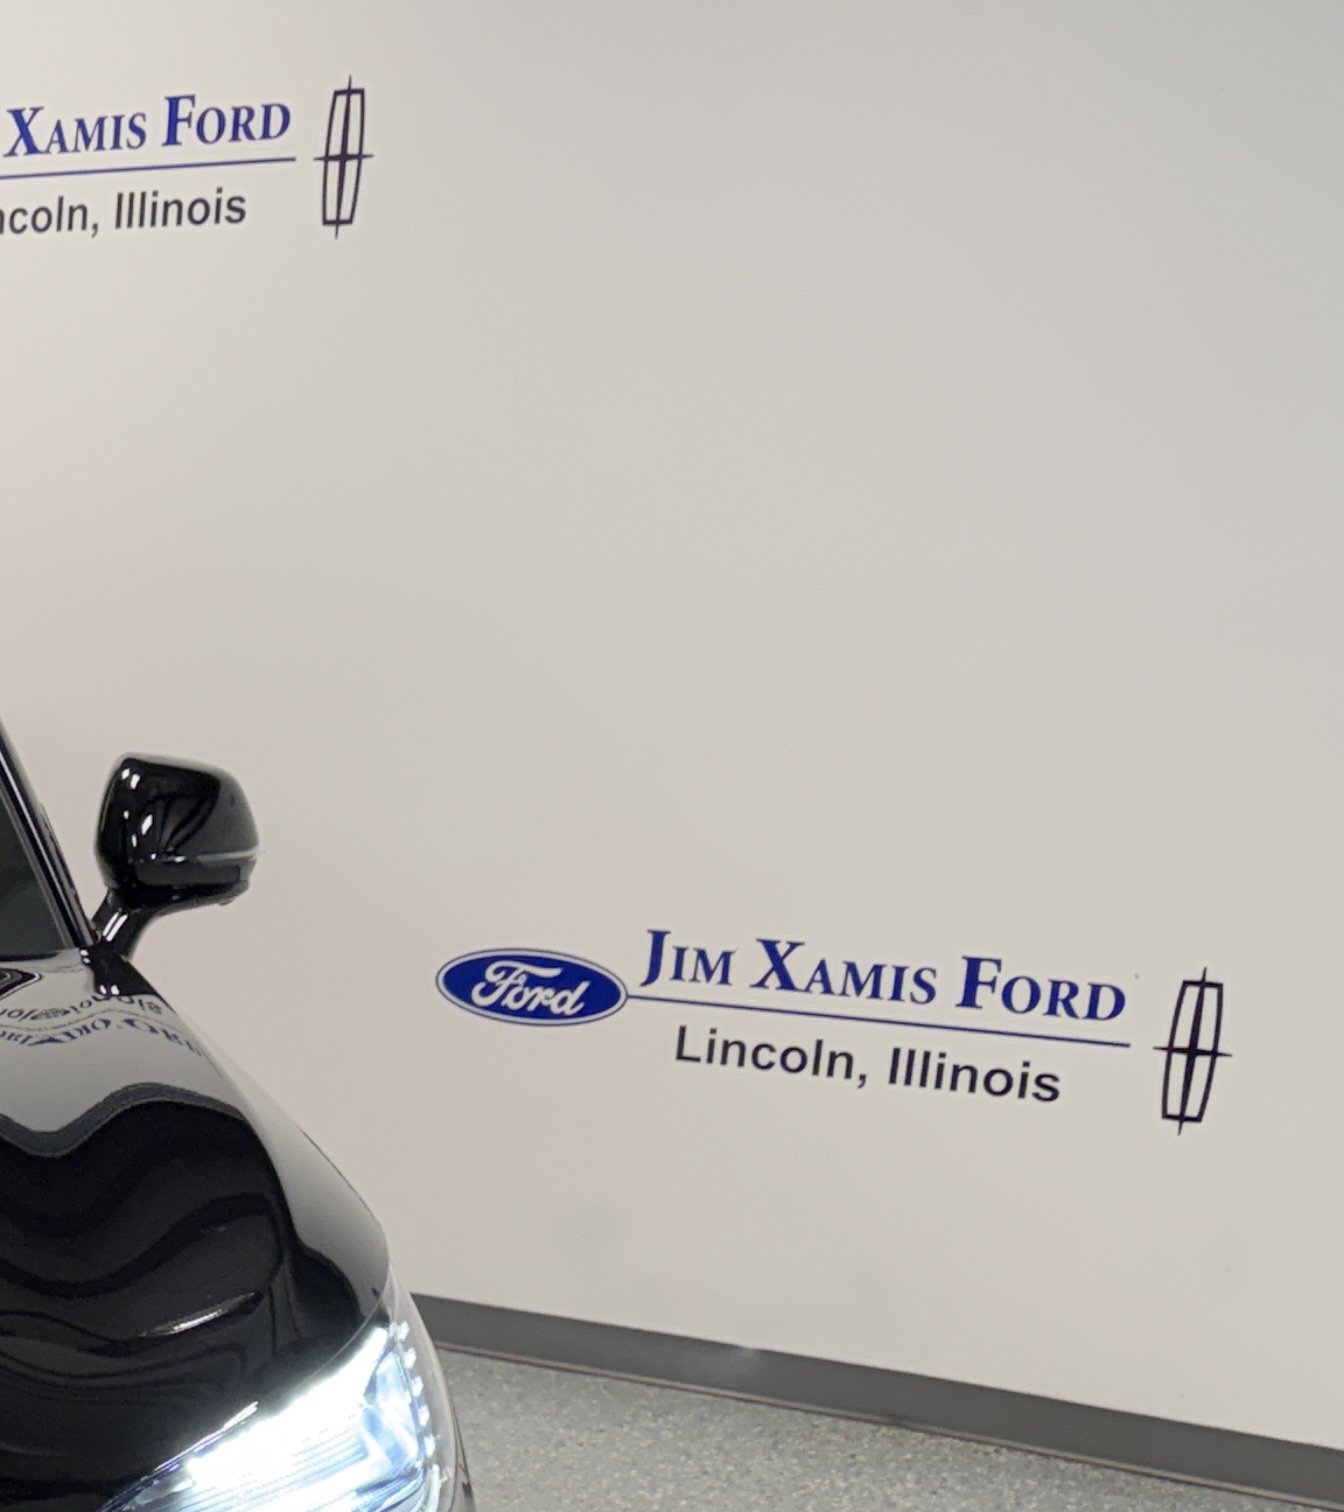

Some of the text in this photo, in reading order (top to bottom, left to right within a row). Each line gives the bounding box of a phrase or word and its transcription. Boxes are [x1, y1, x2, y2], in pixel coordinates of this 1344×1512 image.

[3, 106, 147, 158] XAMIS
[161, 94, 291, 147] FORD
[115, 187, 246, 229] Illinois
[470, 959, 587, 1017] Ford
[639, 929, 1126, 1021] JIM XAMIS FORD
[675, 1025, 1060, 1102] Lincoln, Illinois
